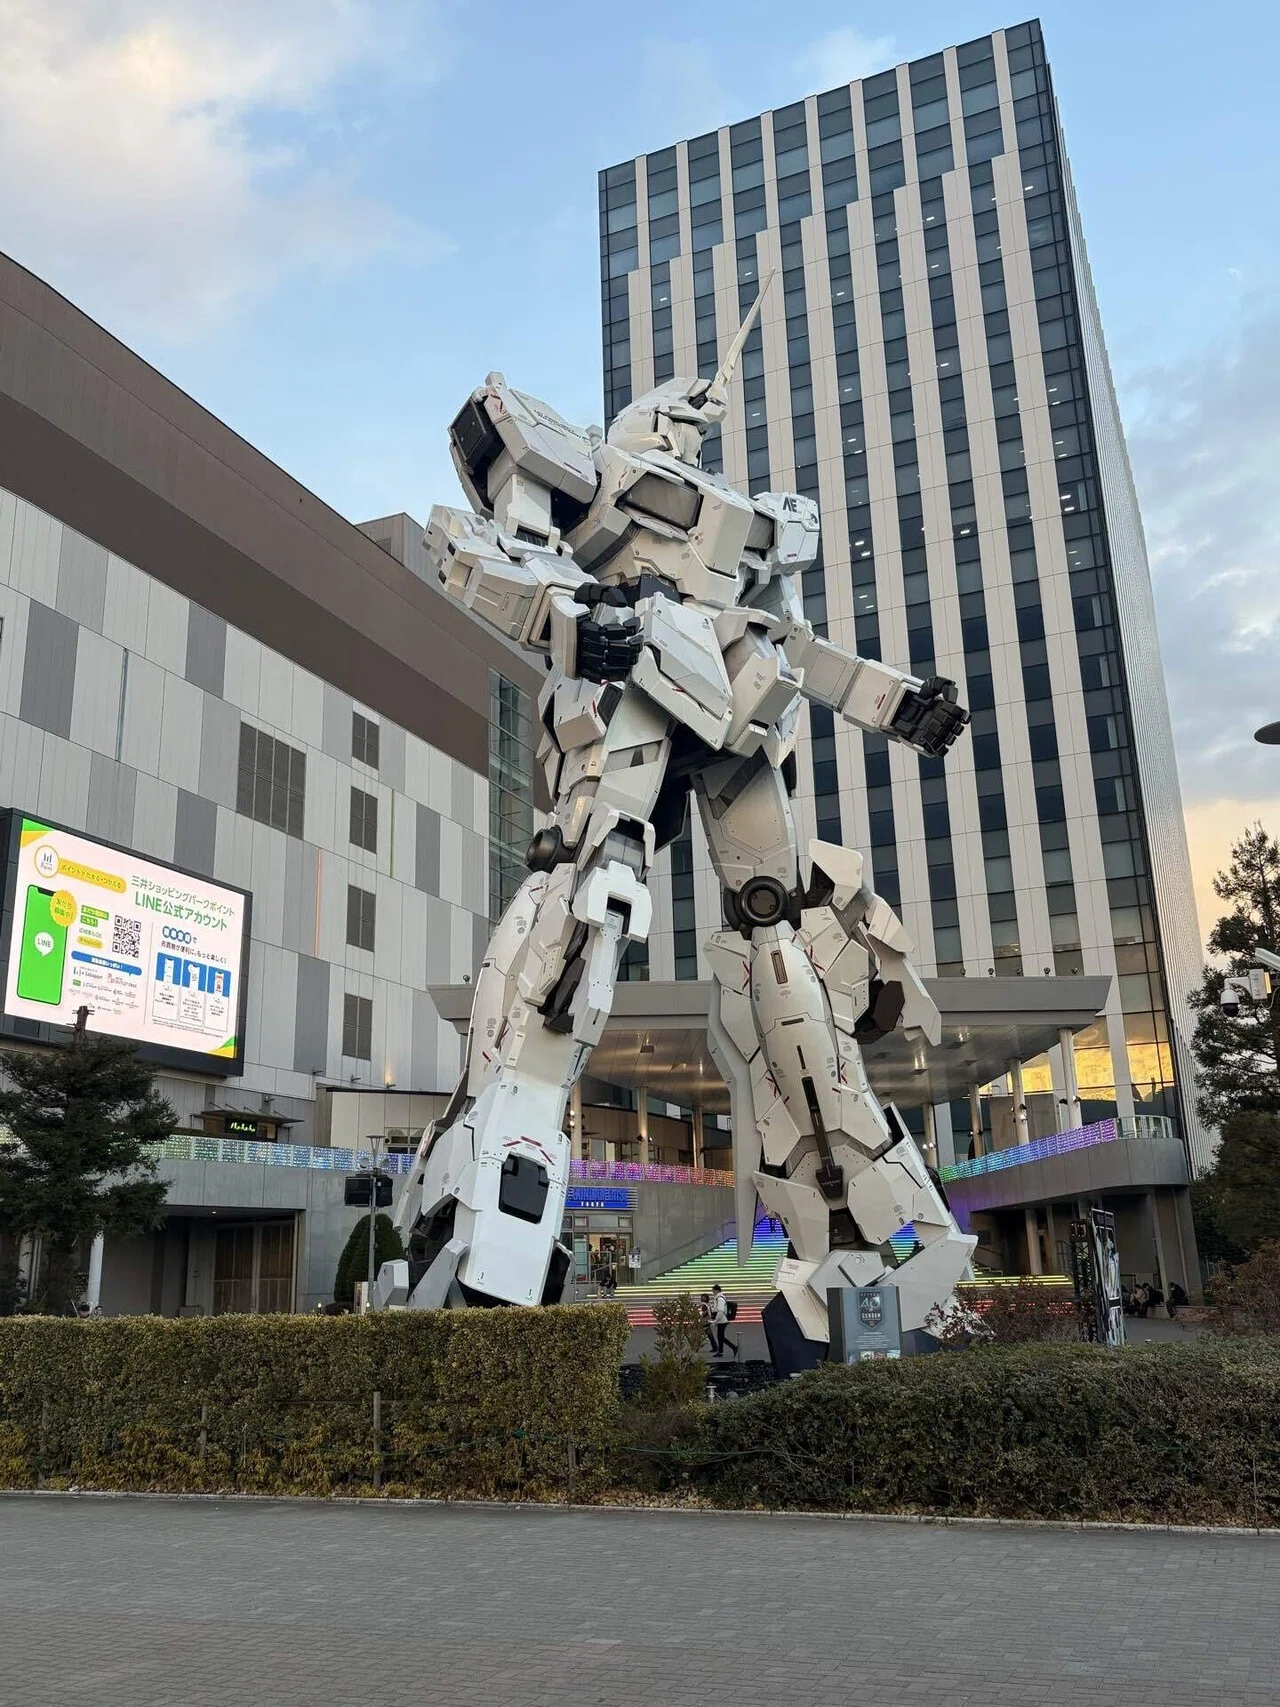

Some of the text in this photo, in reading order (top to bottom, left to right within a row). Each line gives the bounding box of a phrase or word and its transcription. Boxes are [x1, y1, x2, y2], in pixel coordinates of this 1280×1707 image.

[131, 875, 235, 917] 三井ショッピングパークポイント
[135, 891, 228, 931] LINE公式アカウント
[37, 937, 51, 948] LINE
